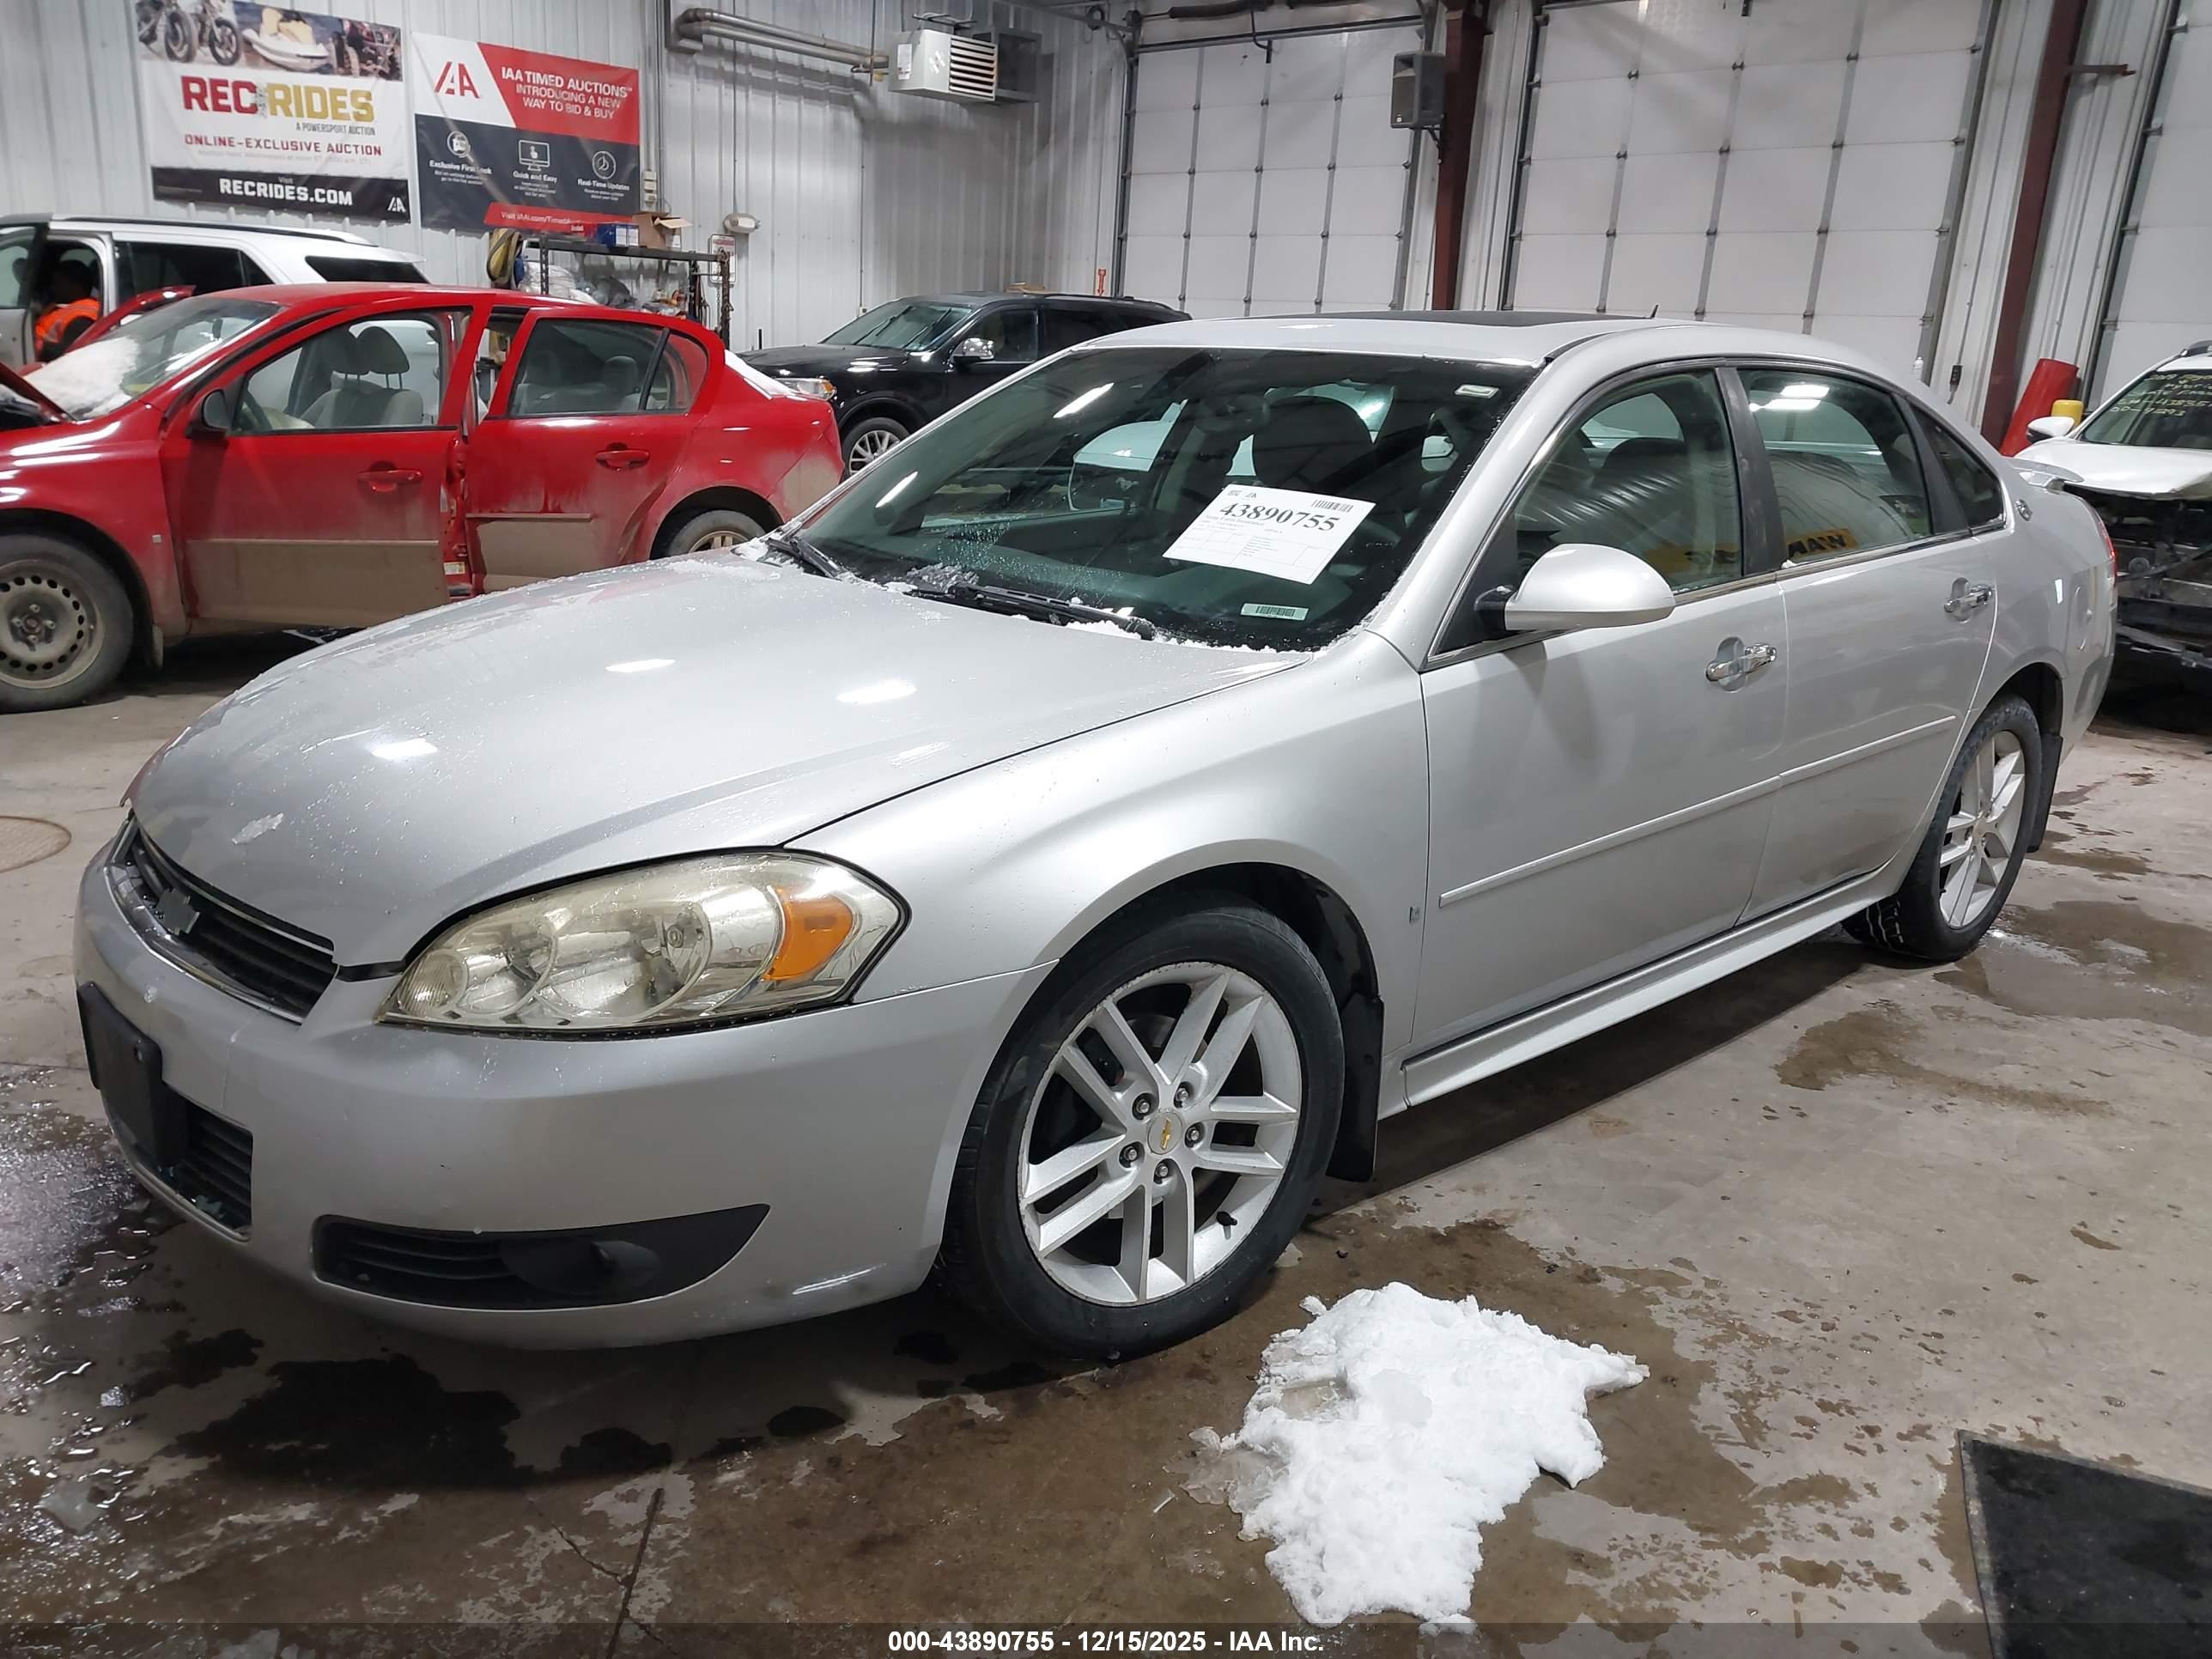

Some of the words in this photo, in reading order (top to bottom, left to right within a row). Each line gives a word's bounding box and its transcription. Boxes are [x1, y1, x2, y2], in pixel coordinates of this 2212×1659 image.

[501, 66, 524, 82] IAA
[525, 70, 564, 88] TIMED
[180, 76, 258, 115] REC
[266, 82, 374, 123] RIDES
[516, 83, 586, 104] INTRODUCING
[587, 95, 596, 105] A
[598, 96, 621, 108] NEW
[522, 97, 547, 109] WAY
[549, 100, 563, 112] TO
[566, 104, 582, 114] BID
[584, 106, 592, 117] &
[593, 107, 615, 119] BUY
[295, 122, 301, 131] A
[349, 125, 376, 137] AUCTION
[185, 134, 322, 153] ONLINE-EXCLUSIVE
[326, 143, 381, 156] AUCTION
[429, 160, 460, 171] Exclusive
[513, 170, 530, 179] Quick
[530, 172, 542, 180] and
[543, 174, 557, 184] Easy
[219, 178, 353, 206] RECRIDES.COM
[1219, 502, 1340, 532] 43890755
